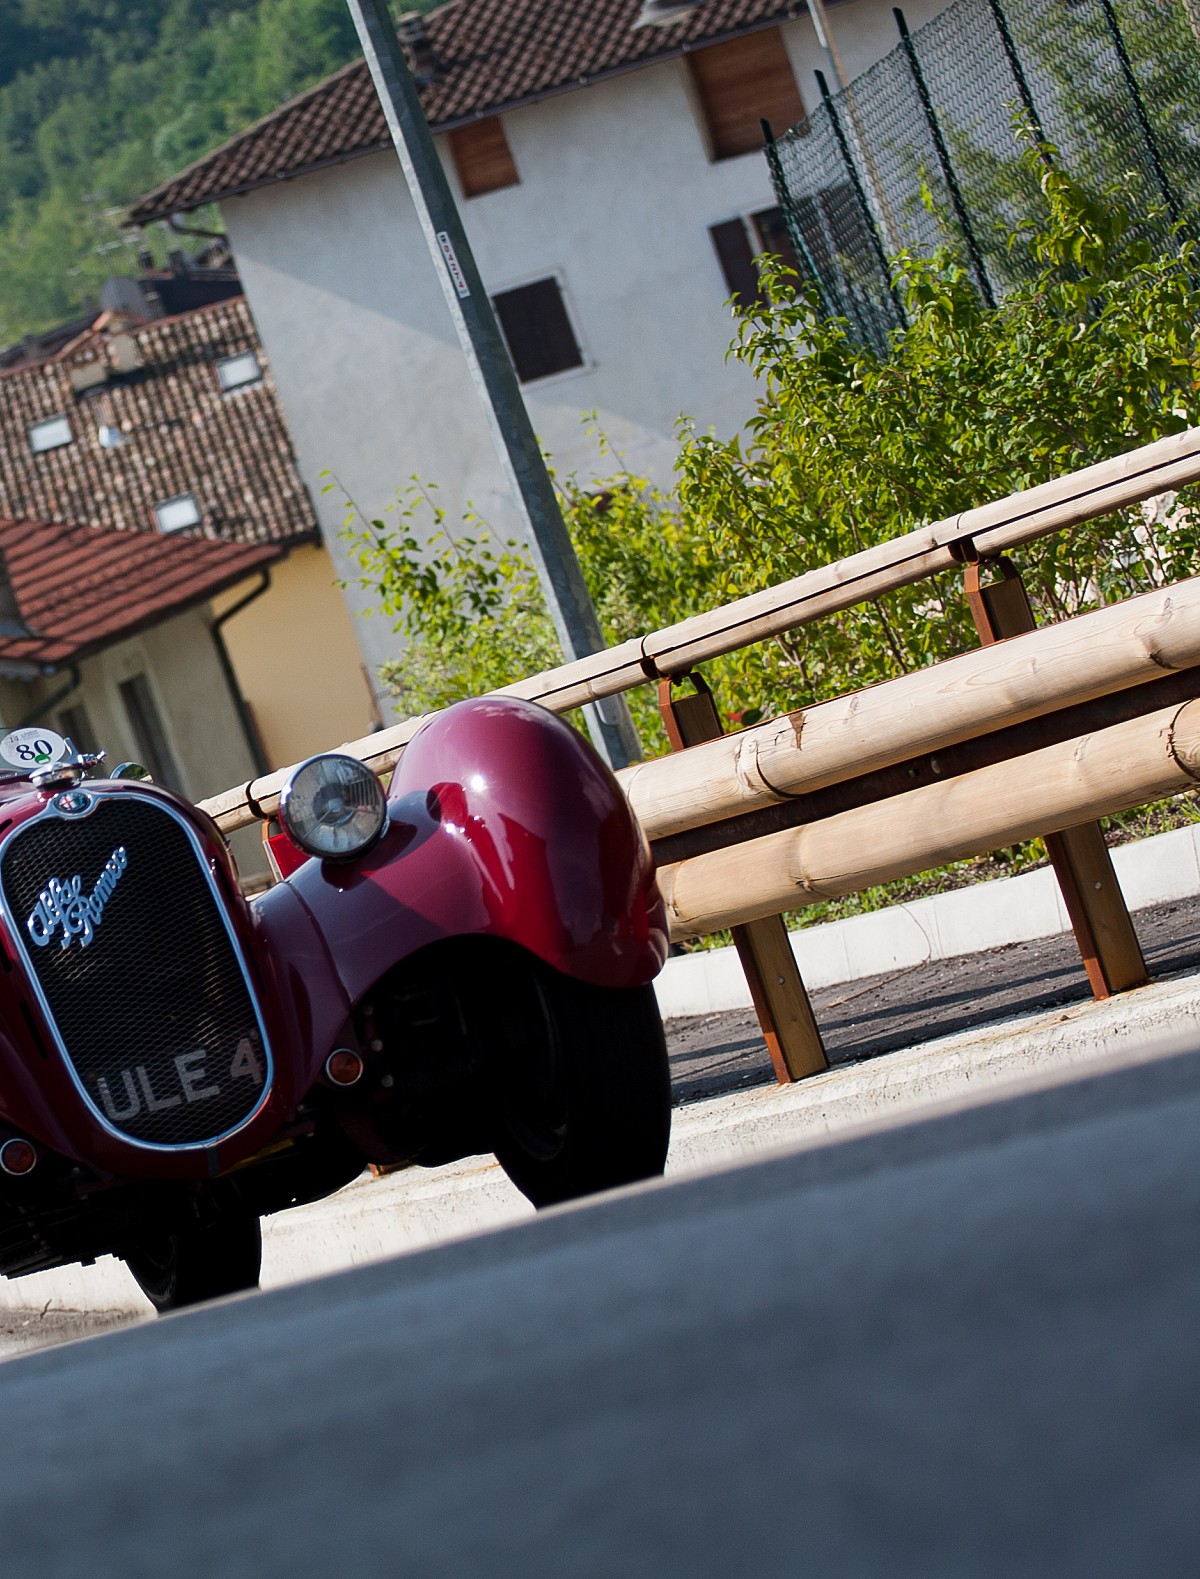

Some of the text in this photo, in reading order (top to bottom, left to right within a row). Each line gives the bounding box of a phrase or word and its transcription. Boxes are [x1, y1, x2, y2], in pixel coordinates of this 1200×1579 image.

[16, 739, 53, 761] 80
[28, 875, 80, 949] Alfa
[64, 846, 128, 947] Romeo
[97, 1037, 262, 1121] ULE 4
